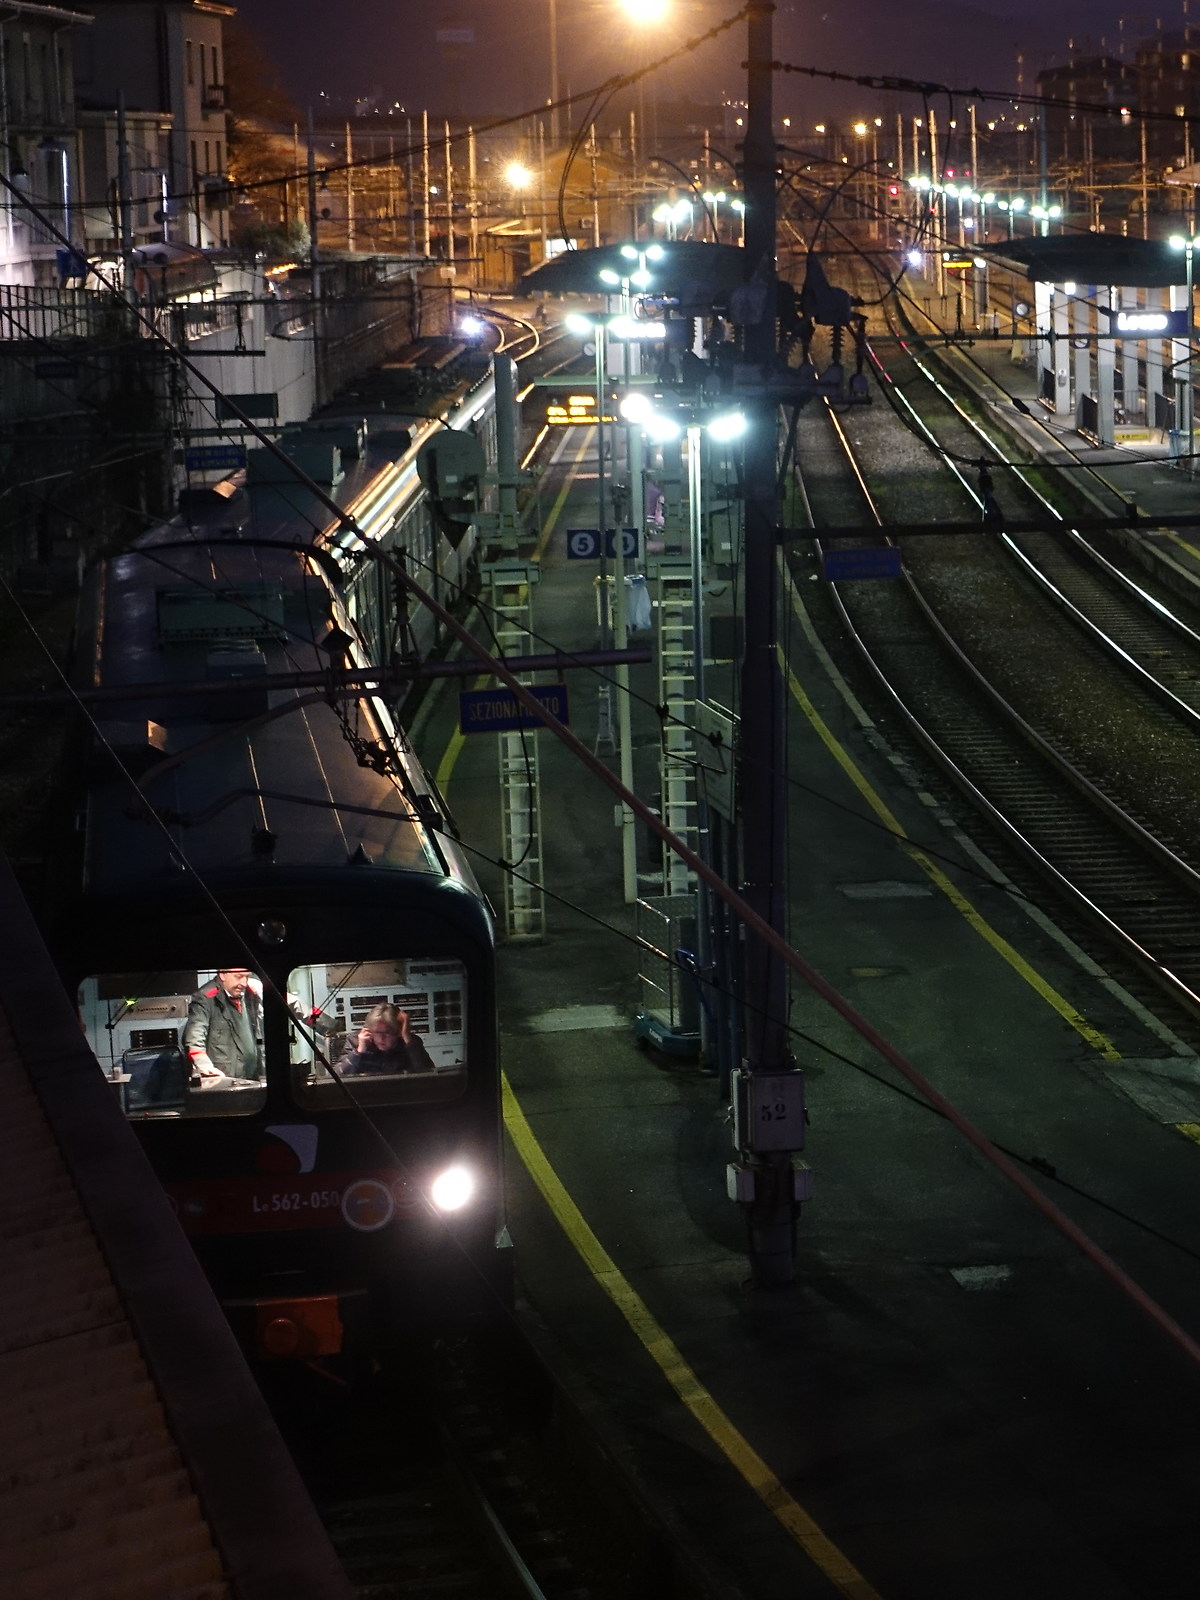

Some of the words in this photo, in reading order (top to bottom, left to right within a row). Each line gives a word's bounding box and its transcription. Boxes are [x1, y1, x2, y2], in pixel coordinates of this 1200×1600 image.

[577, 537, 589, 552] 5
[469, 696, 560, 721] SEZIONAMTO
[761, 1103, 786, 1122] 52
